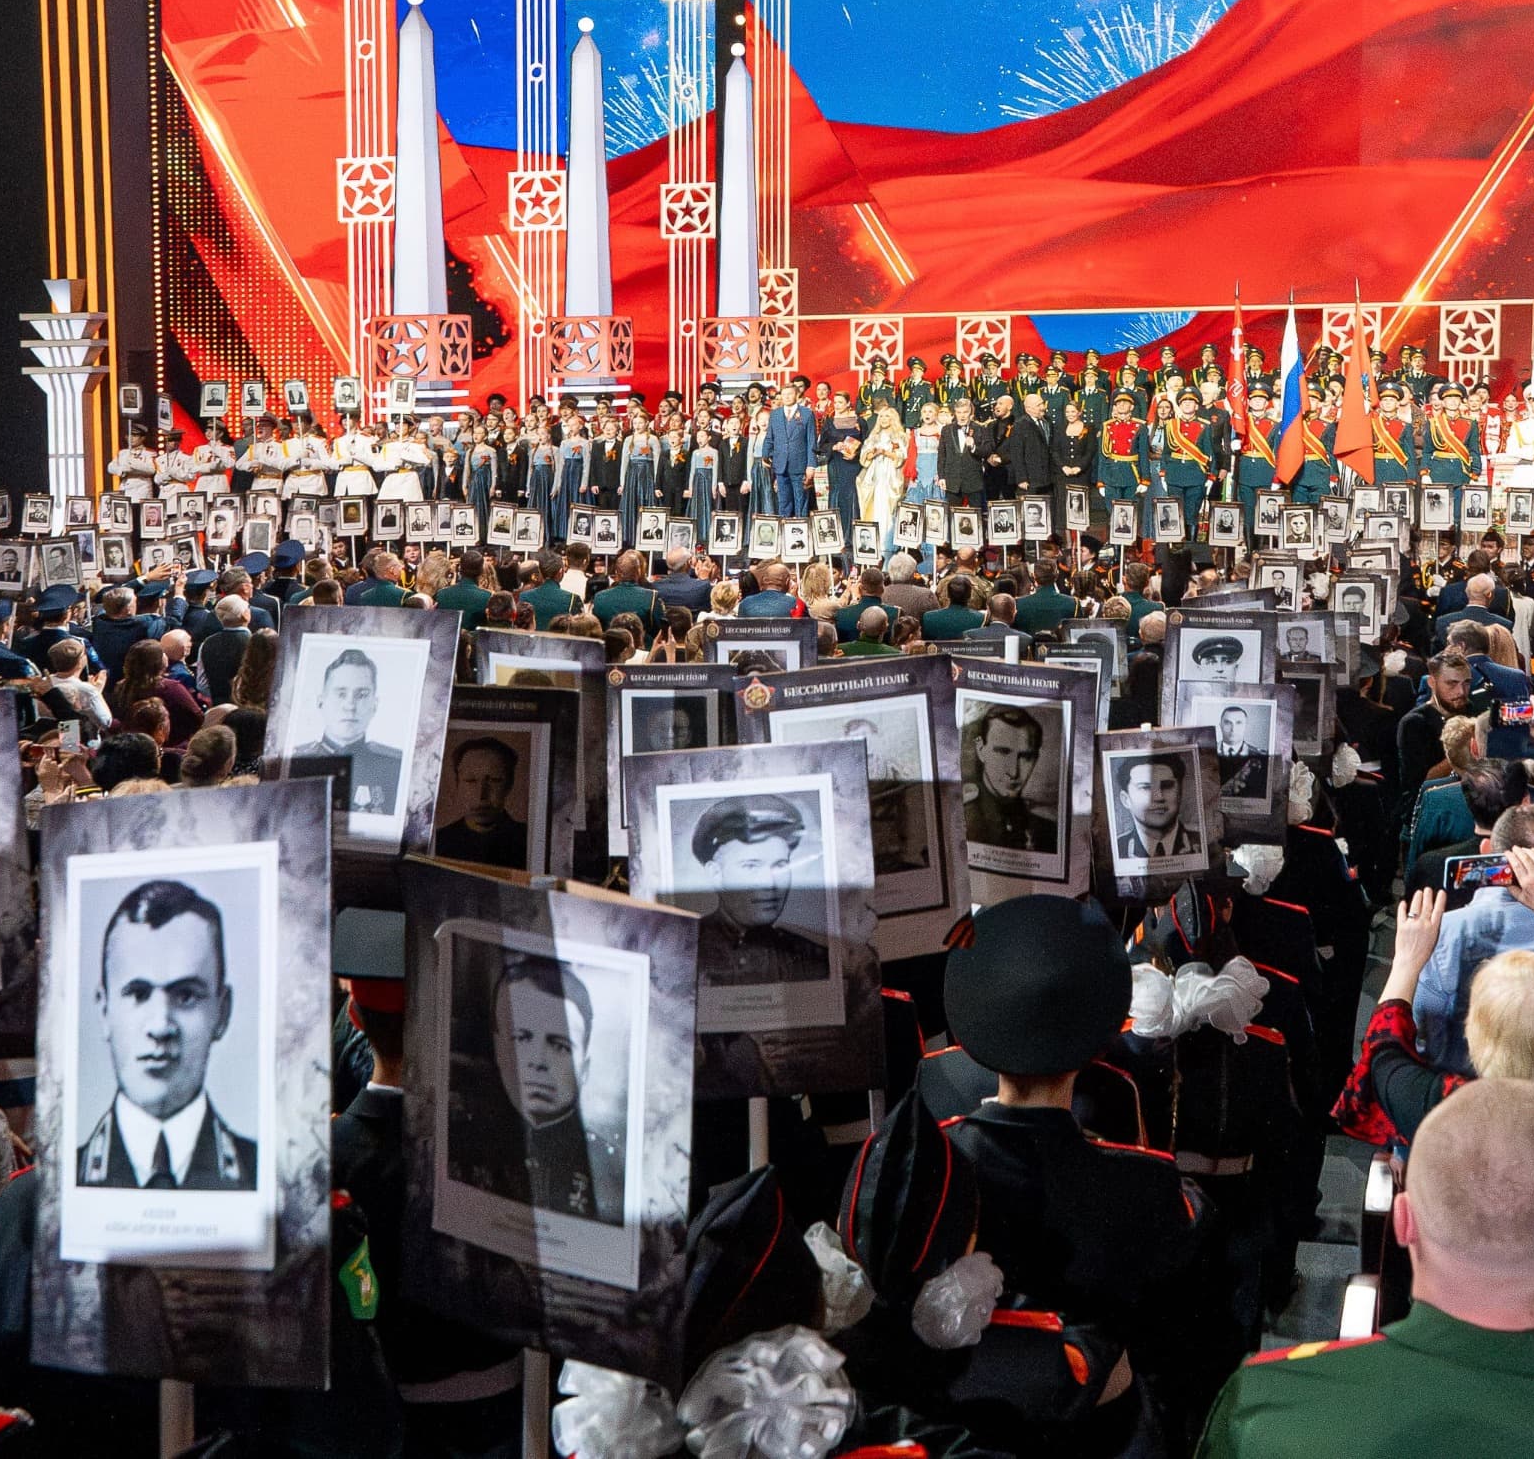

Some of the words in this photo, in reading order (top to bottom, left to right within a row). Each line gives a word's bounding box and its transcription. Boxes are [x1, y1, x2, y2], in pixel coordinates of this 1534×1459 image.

[783, 677, 874, 698] БЕССМЕРТНЫЙ
[876, 673, 910, 688] ПОЛК
[967, 670, 1030, 687] БЕССМЕРТНЫЙ
[1031, 677, 1060, 690] ПОЛК
